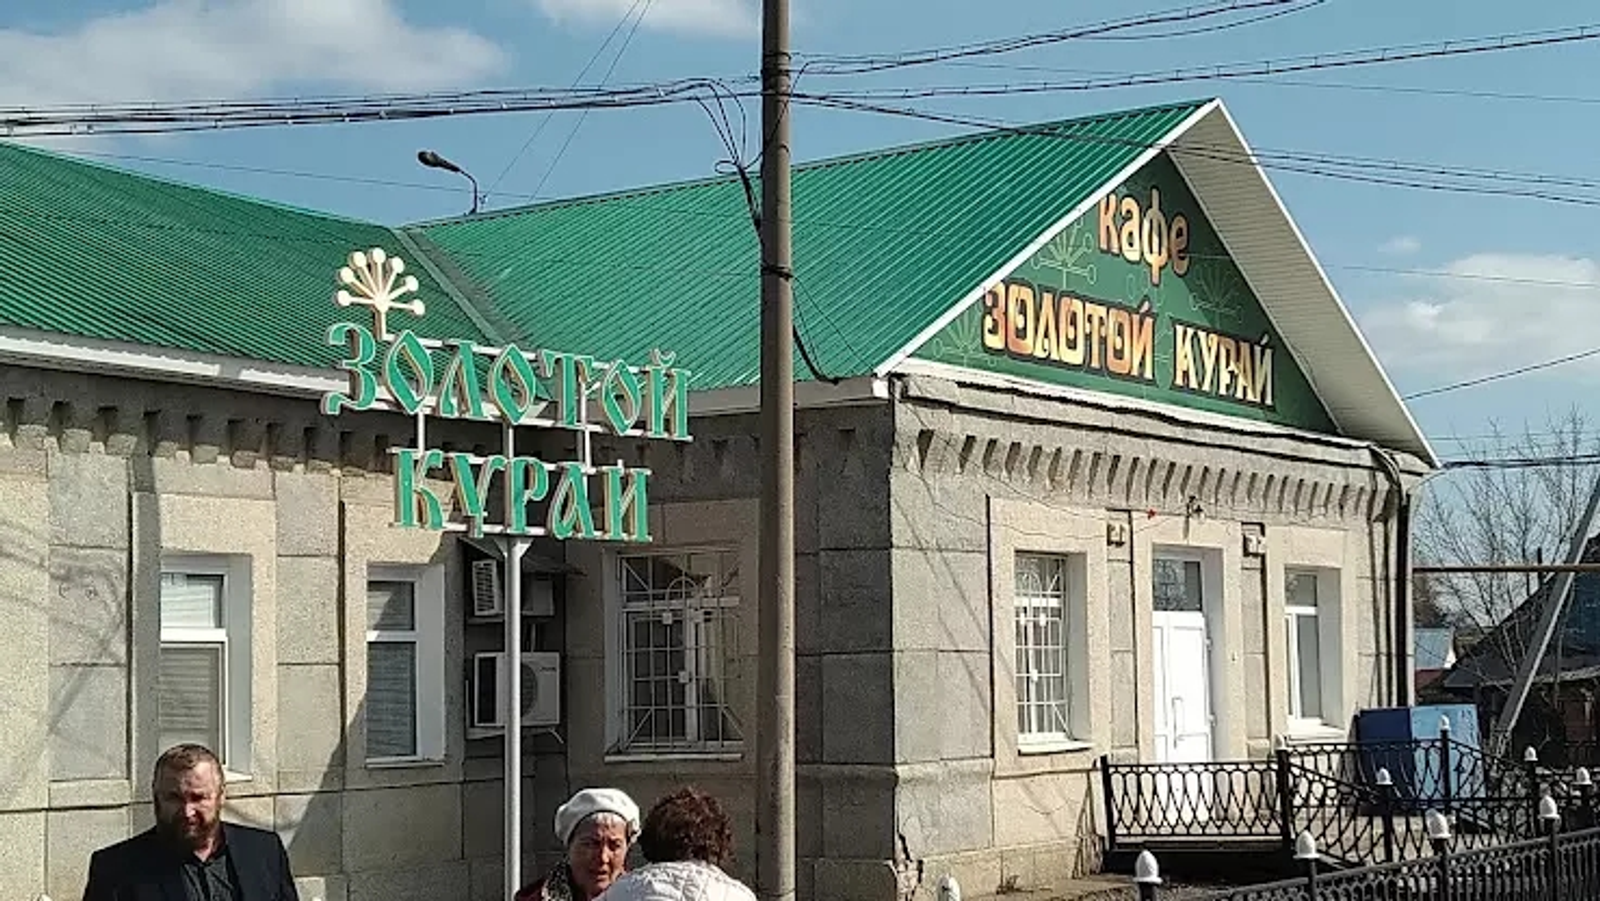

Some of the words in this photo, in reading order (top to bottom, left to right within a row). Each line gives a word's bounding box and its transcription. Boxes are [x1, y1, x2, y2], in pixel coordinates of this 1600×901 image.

[1098, 186, 1190, 285] кафе
[321, 322, 693, 440] ЗОЛОТОЙ
[983, 281, 1154, 381] ЗОЛОТОЙ
[1173, 323, 1273, 406] КУРАЙ
